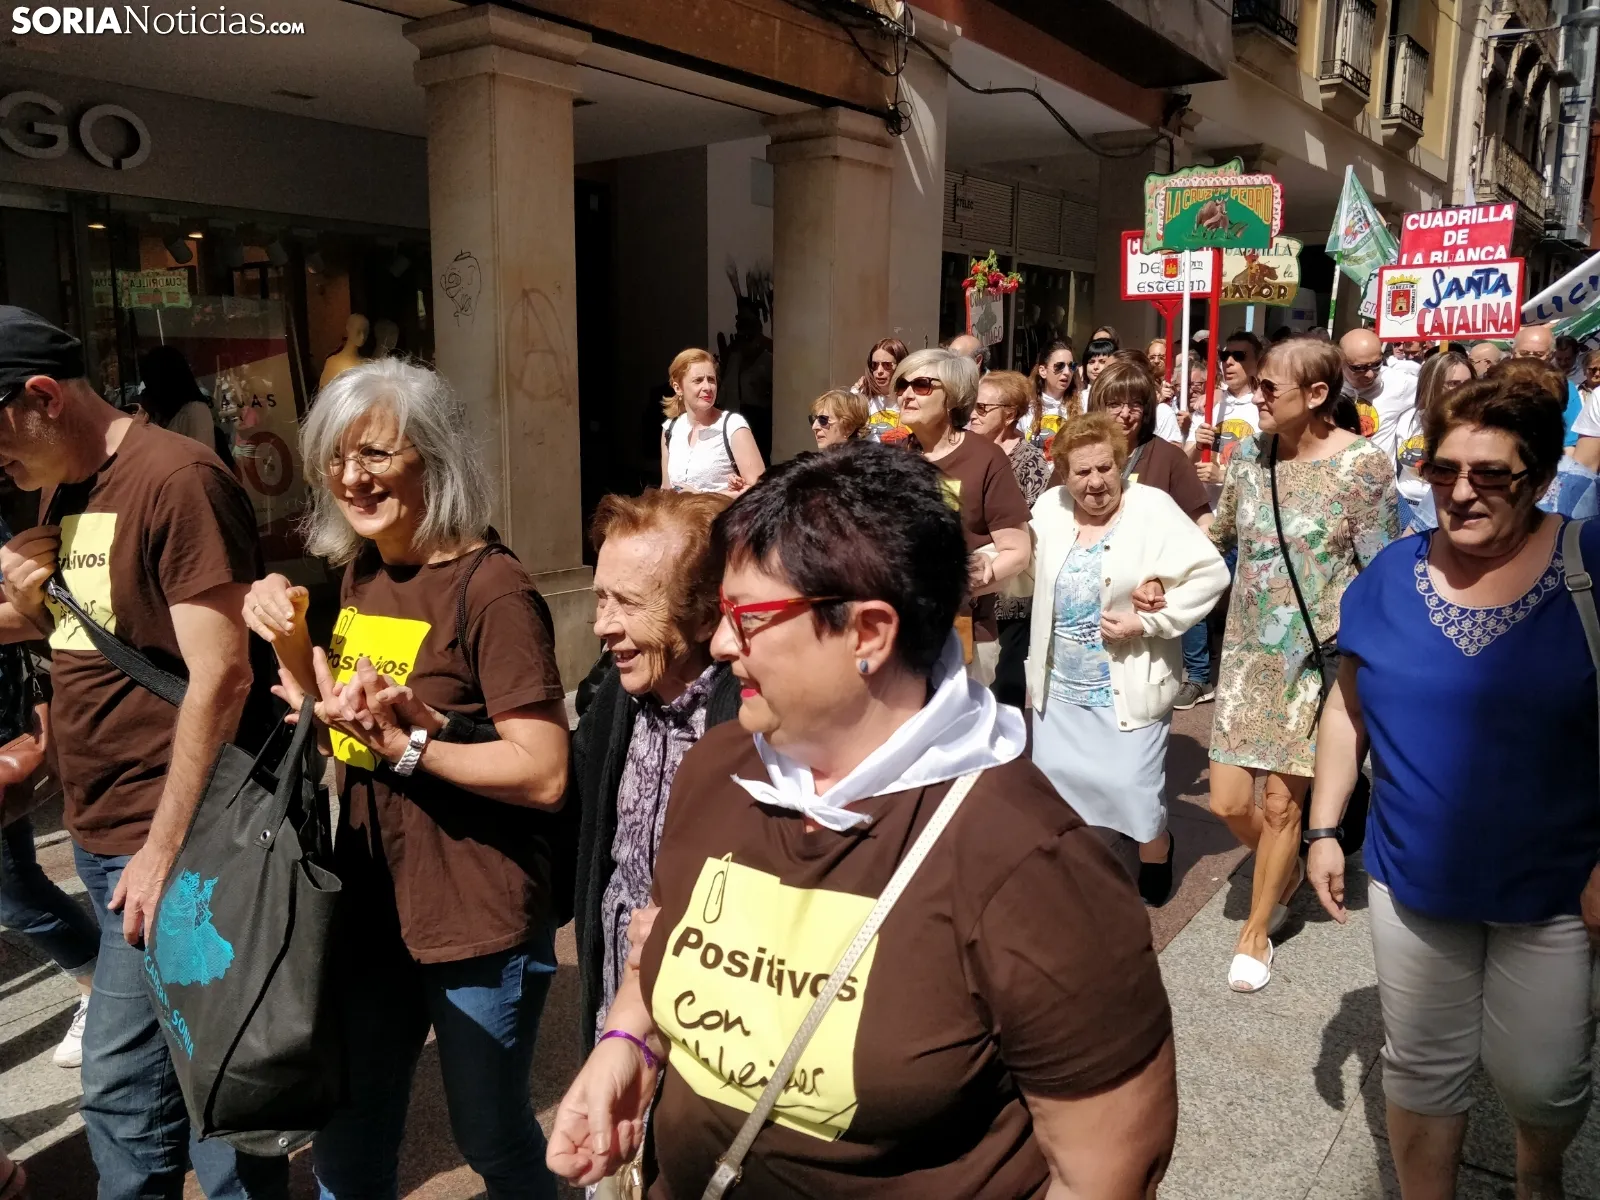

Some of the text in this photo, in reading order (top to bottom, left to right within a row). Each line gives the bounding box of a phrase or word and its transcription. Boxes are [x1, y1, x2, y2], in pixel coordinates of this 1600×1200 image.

[1406, 204, 1513, 231] CUADRILLA
[1443, 229, 1469, 247] DE
[1430, 245, 1508, 264] BLANCA
[1416, 301, 1514, 336] CATALINA
[674, 990, 751, 1036] Con
